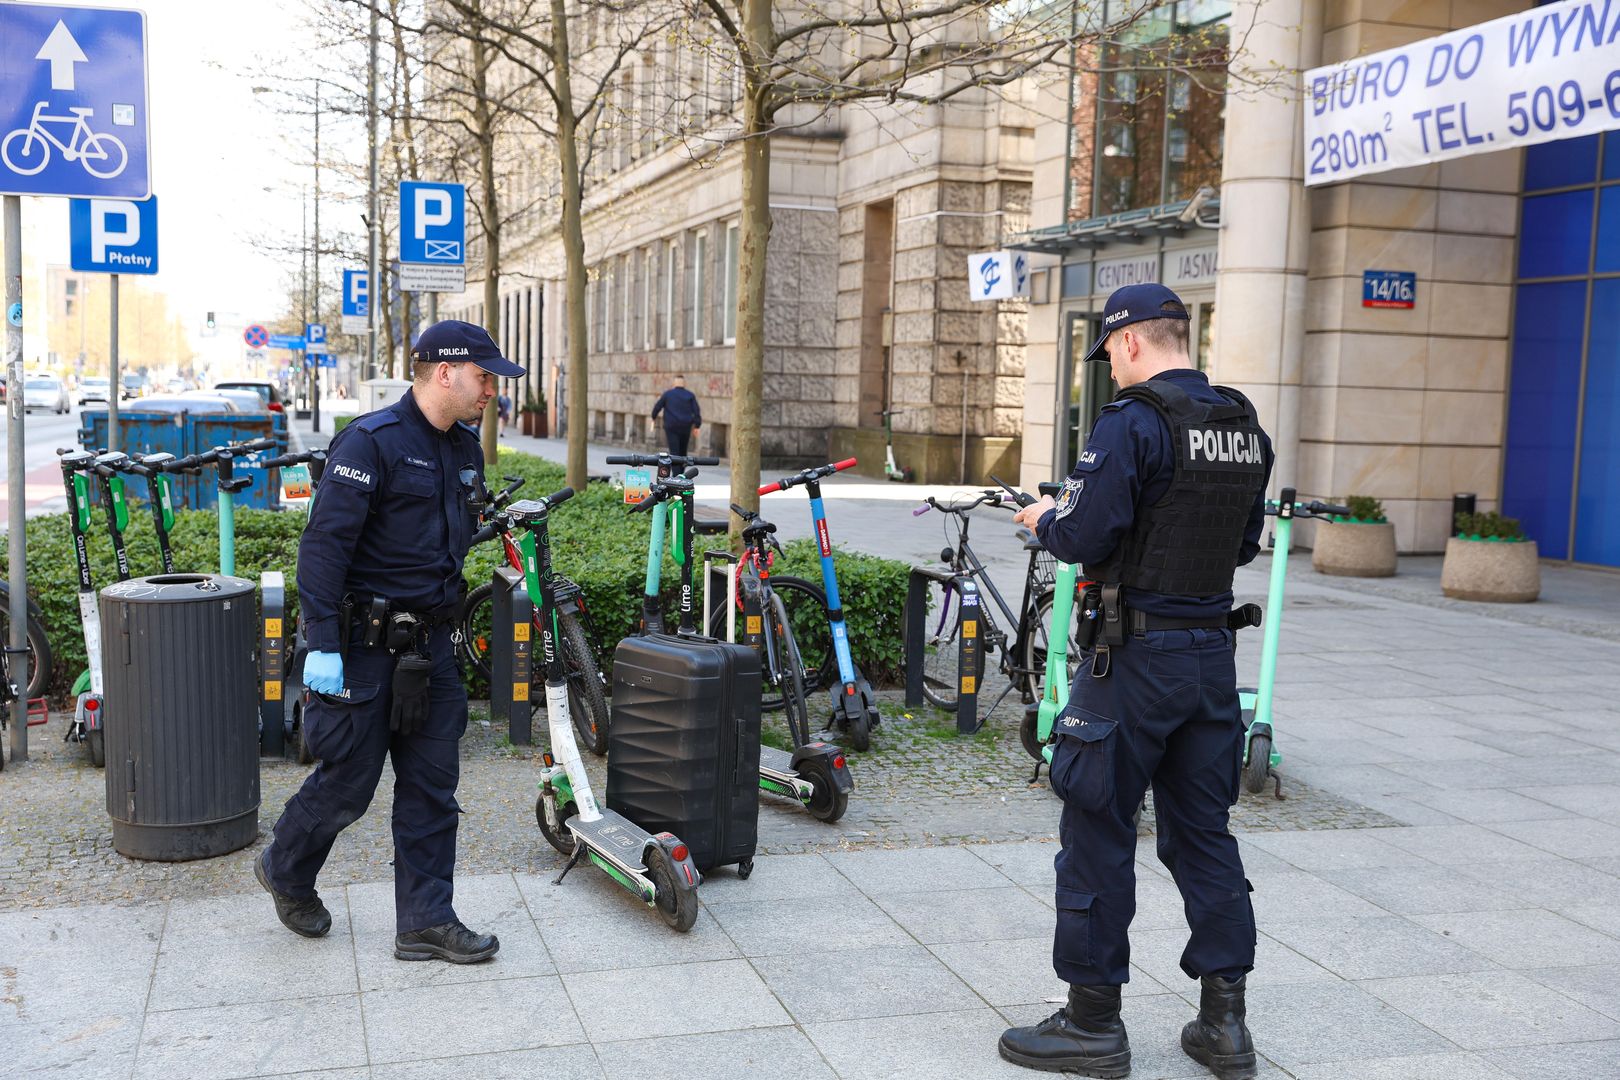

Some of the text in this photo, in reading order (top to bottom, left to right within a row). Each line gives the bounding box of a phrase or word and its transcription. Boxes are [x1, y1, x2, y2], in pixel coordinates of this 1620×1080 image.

[1312, 54, 1409, 117] BIURO
[1425, 34, 1484, 88] DO
[1412, 100, 1495, 154] TEL.
[414, 188, 452, 240] P
[90, 199, 140, 264] P
[109, 251, 152, 268] Płatny
[1098, 260, 1157, 288] CENTRUM
[1105, 309, 1129, 325] POLICJA
[309, 325, 323, 342] P
[438, 347, 469, 357] POLICJA
[1188, 429, 1263, 465] POLICJA
[333, 464, 371, 485] POLICJA
[117, 548, 129, 574] Lime
[681, 584, 691, 612] Lime
[543, 630, 554, 665] Lime
